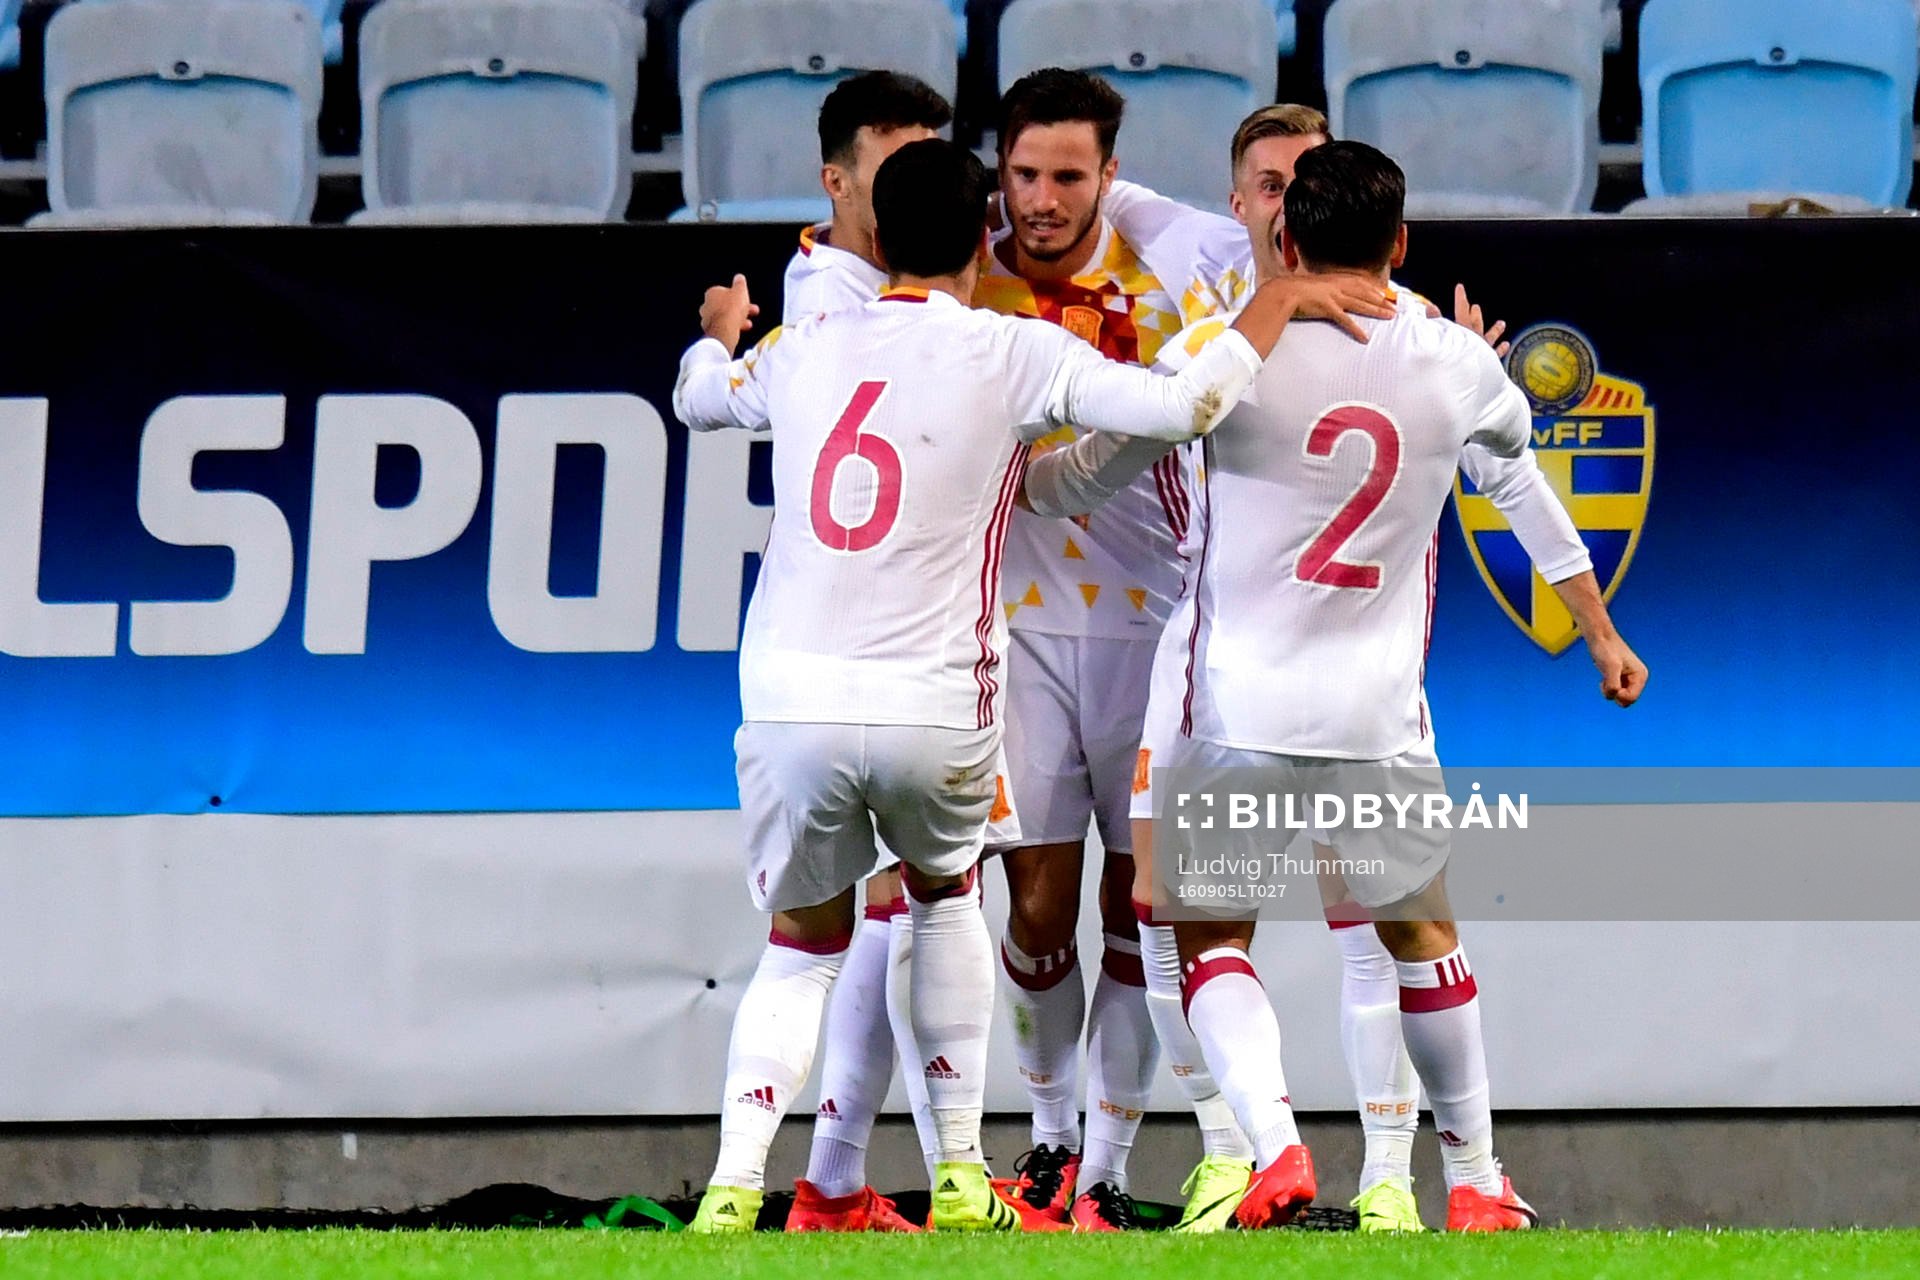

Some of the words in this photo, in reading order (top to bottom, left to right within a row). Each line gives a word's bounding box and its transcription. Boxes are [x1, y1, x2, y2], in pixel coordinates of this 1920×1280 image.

[1532, 421, 1603, 446] vFF
[808, 379, 905, 553] 6
[1295, 402, 1403, 590] 2
[1172, 1065, 1193, 1077] EF
[737, 1096, 777, 1115] adidas
